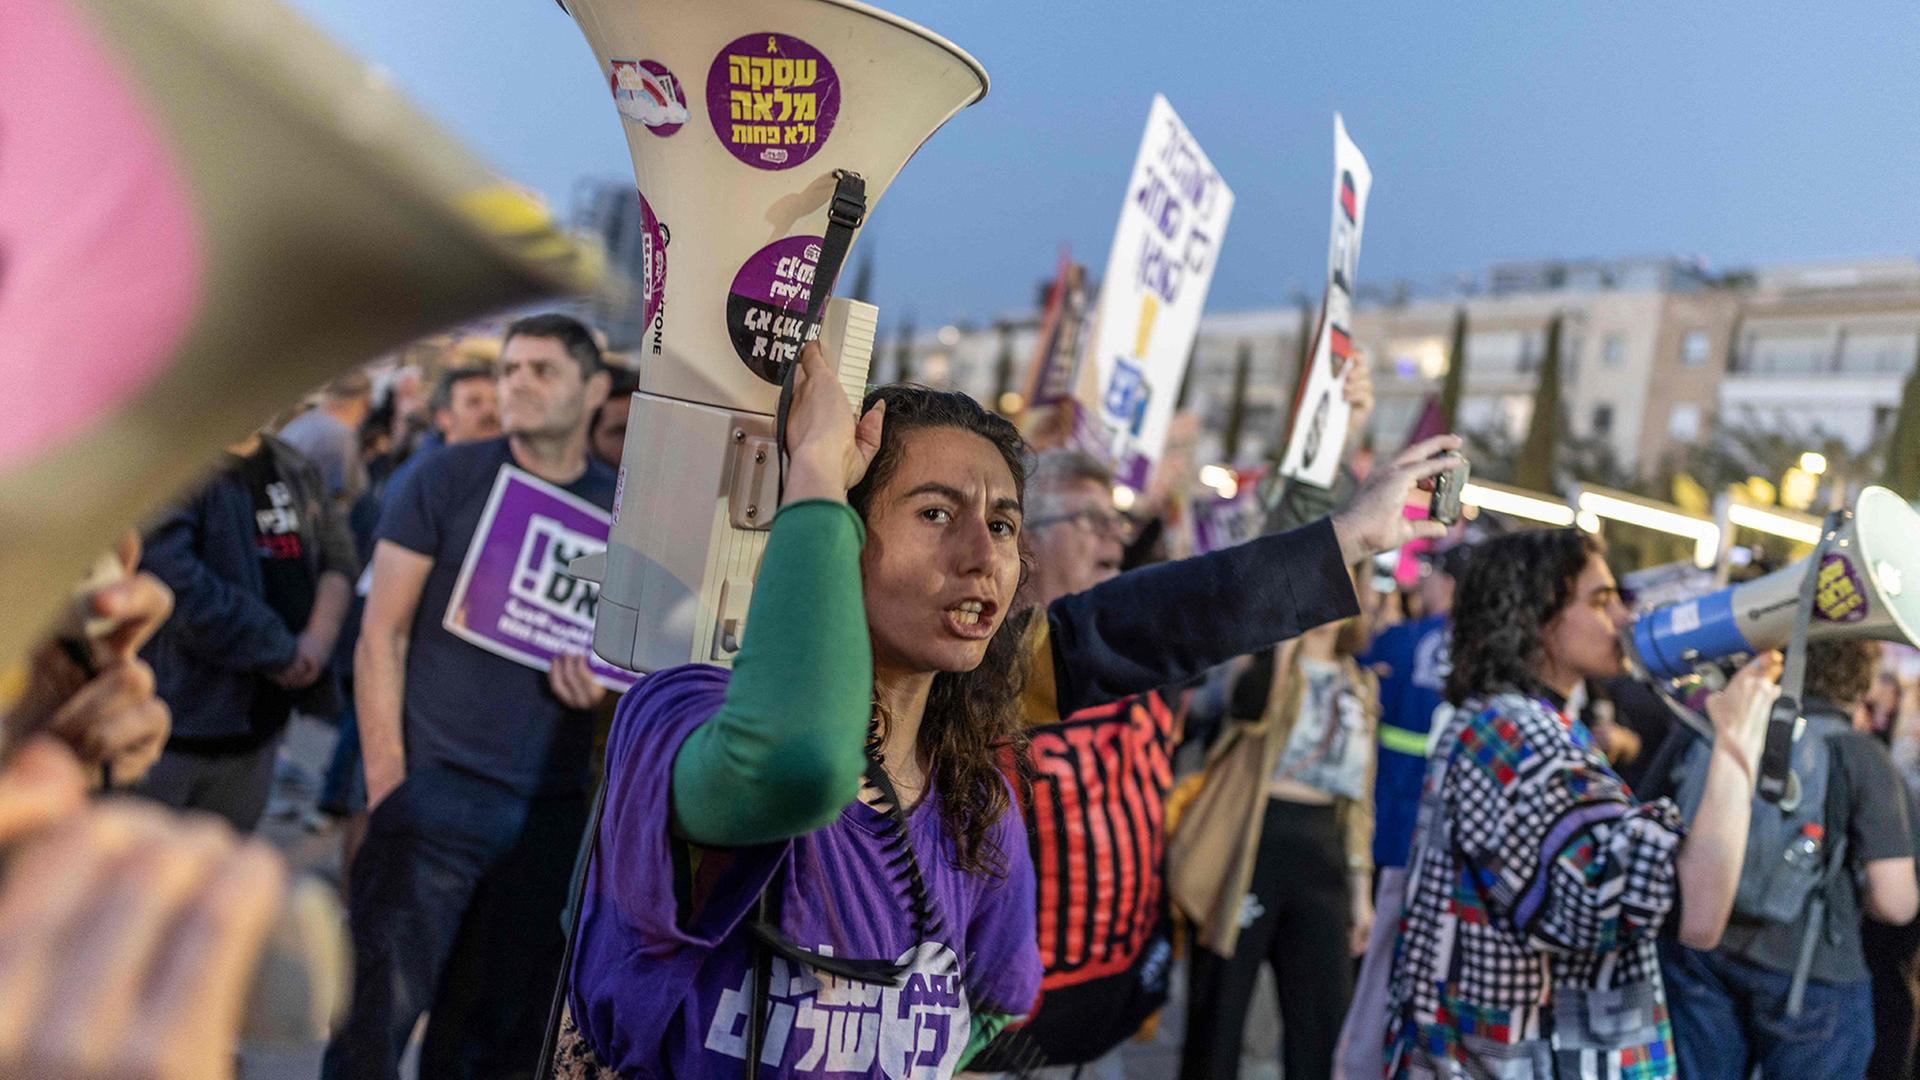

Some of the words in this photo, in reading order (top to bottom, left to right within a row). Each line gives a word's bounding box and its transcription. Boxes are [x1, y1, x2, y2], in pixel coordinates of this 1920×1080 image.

[728, 54, 818, 92] עסקה
[730, 88, 817, 122] מלאה
[731, 123, 781, 145] פחות
[784, 122, 816, 145] ולא
[744, 307, 773, 331] לא
[704, 986, 881, 1073] שלום
